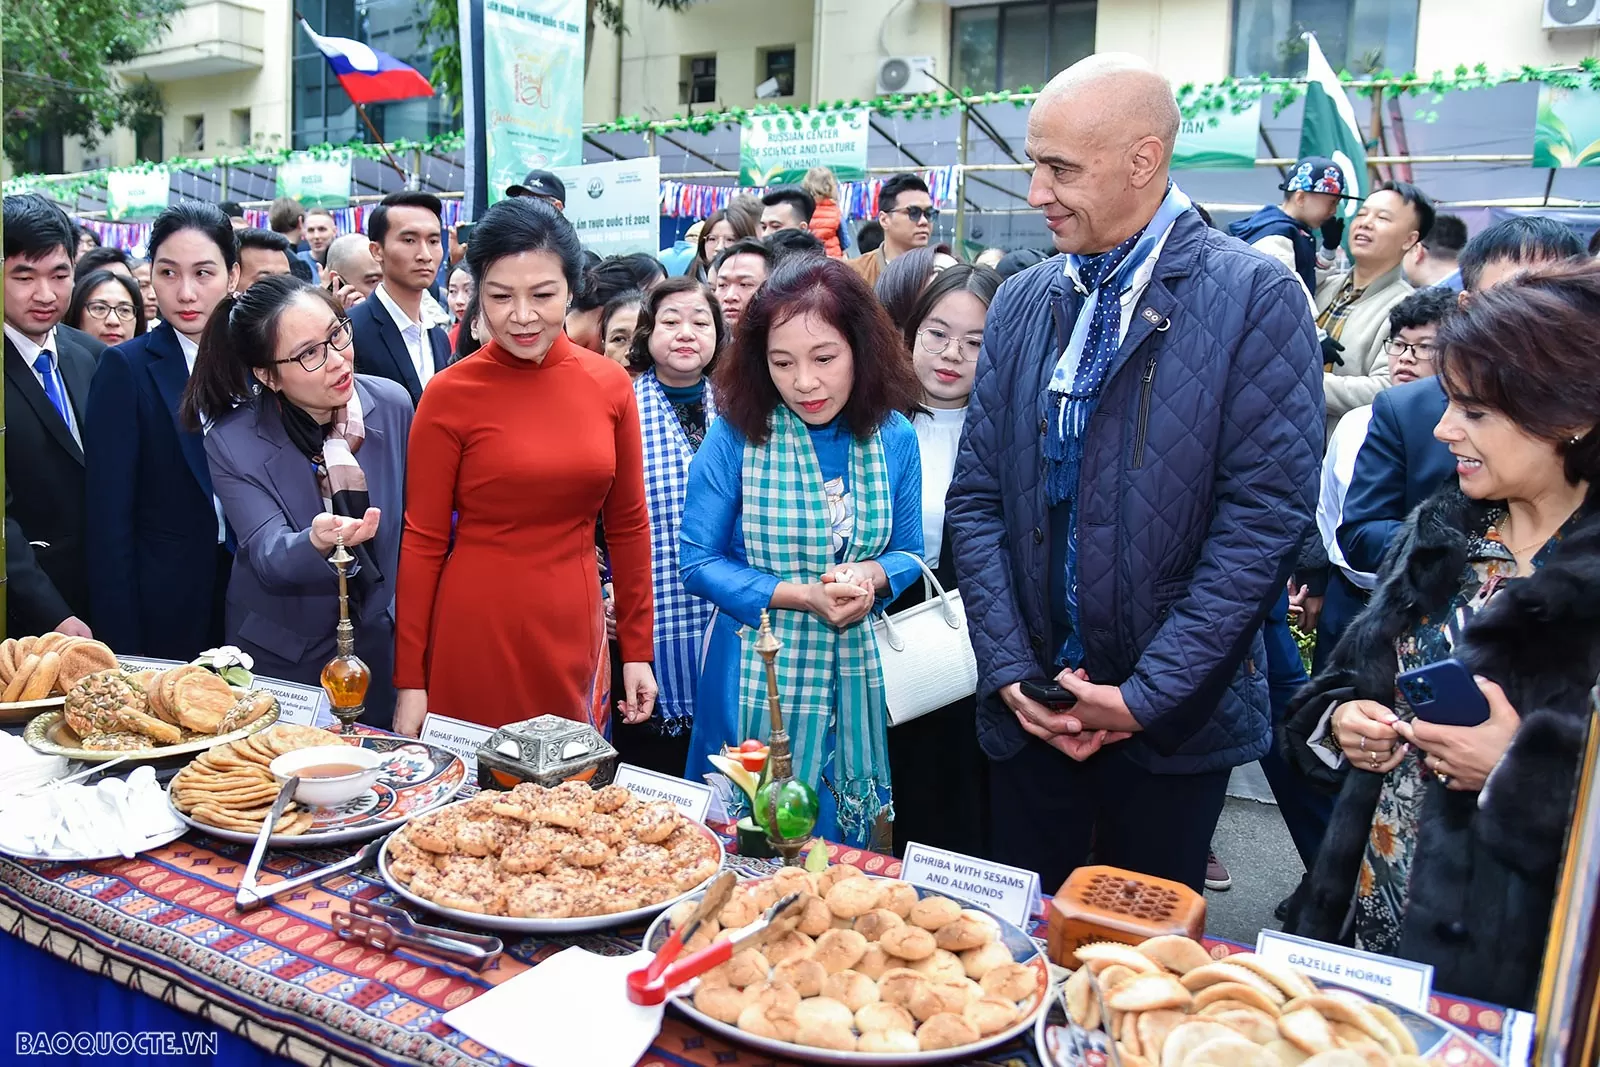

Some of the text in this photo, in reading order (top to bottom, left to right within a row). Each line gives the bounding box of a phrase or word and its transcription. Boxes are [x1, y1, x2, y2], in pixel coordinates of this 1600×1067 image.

[768, 129, 838, 142] RUSSIAN CENTER
[762, 144, 796, 156] SCIENCE
[800, 143, 817, 154] AND
[820, 142, 856, 153] CULTURE
[634, 215, 650, 225] 2024
[291, 693, 308, 701] BREAD
[430, 730, 482, 748] RGHAIF WITH HO
[461, 750, 476, 759] VND
[627, 782, 693, 807] PEANUT PASTRIES
[913, 854, 1024, 889] GHRIBA WITH SESAMS
[926, 872, 1004, 899] AND ALMONDS
[1288, 954, 1392, 986] GAZELLE HORNS
